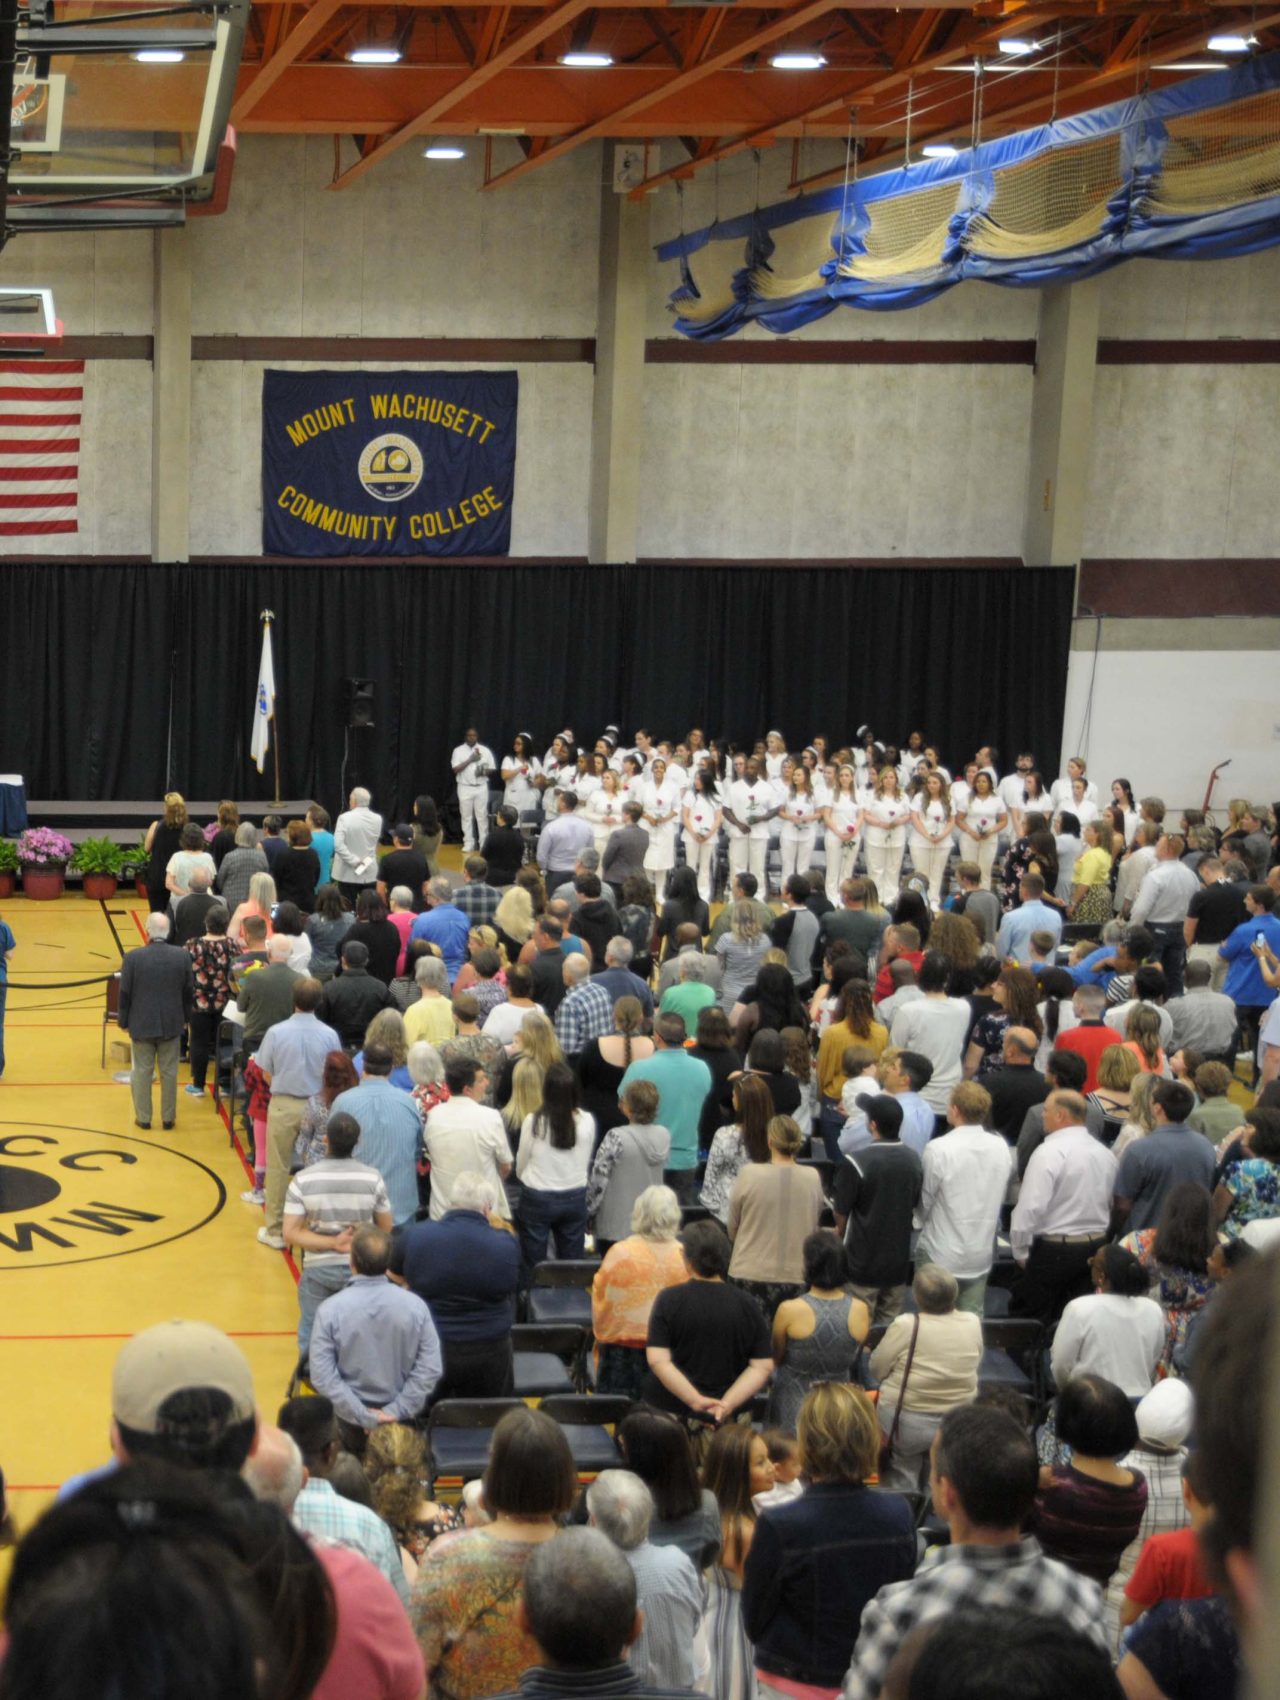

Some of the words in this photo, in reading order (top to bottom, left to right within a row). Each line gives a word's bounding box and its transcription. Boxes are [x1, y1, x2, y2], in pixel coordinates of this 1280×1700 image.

[286, 398, 356, 447] MOUNT
[370, 393, 496, 444] WACHUSETT
[277, 485, 396, 541] COMMUNITY
[409, 485, 503, 539] COLLEGE
